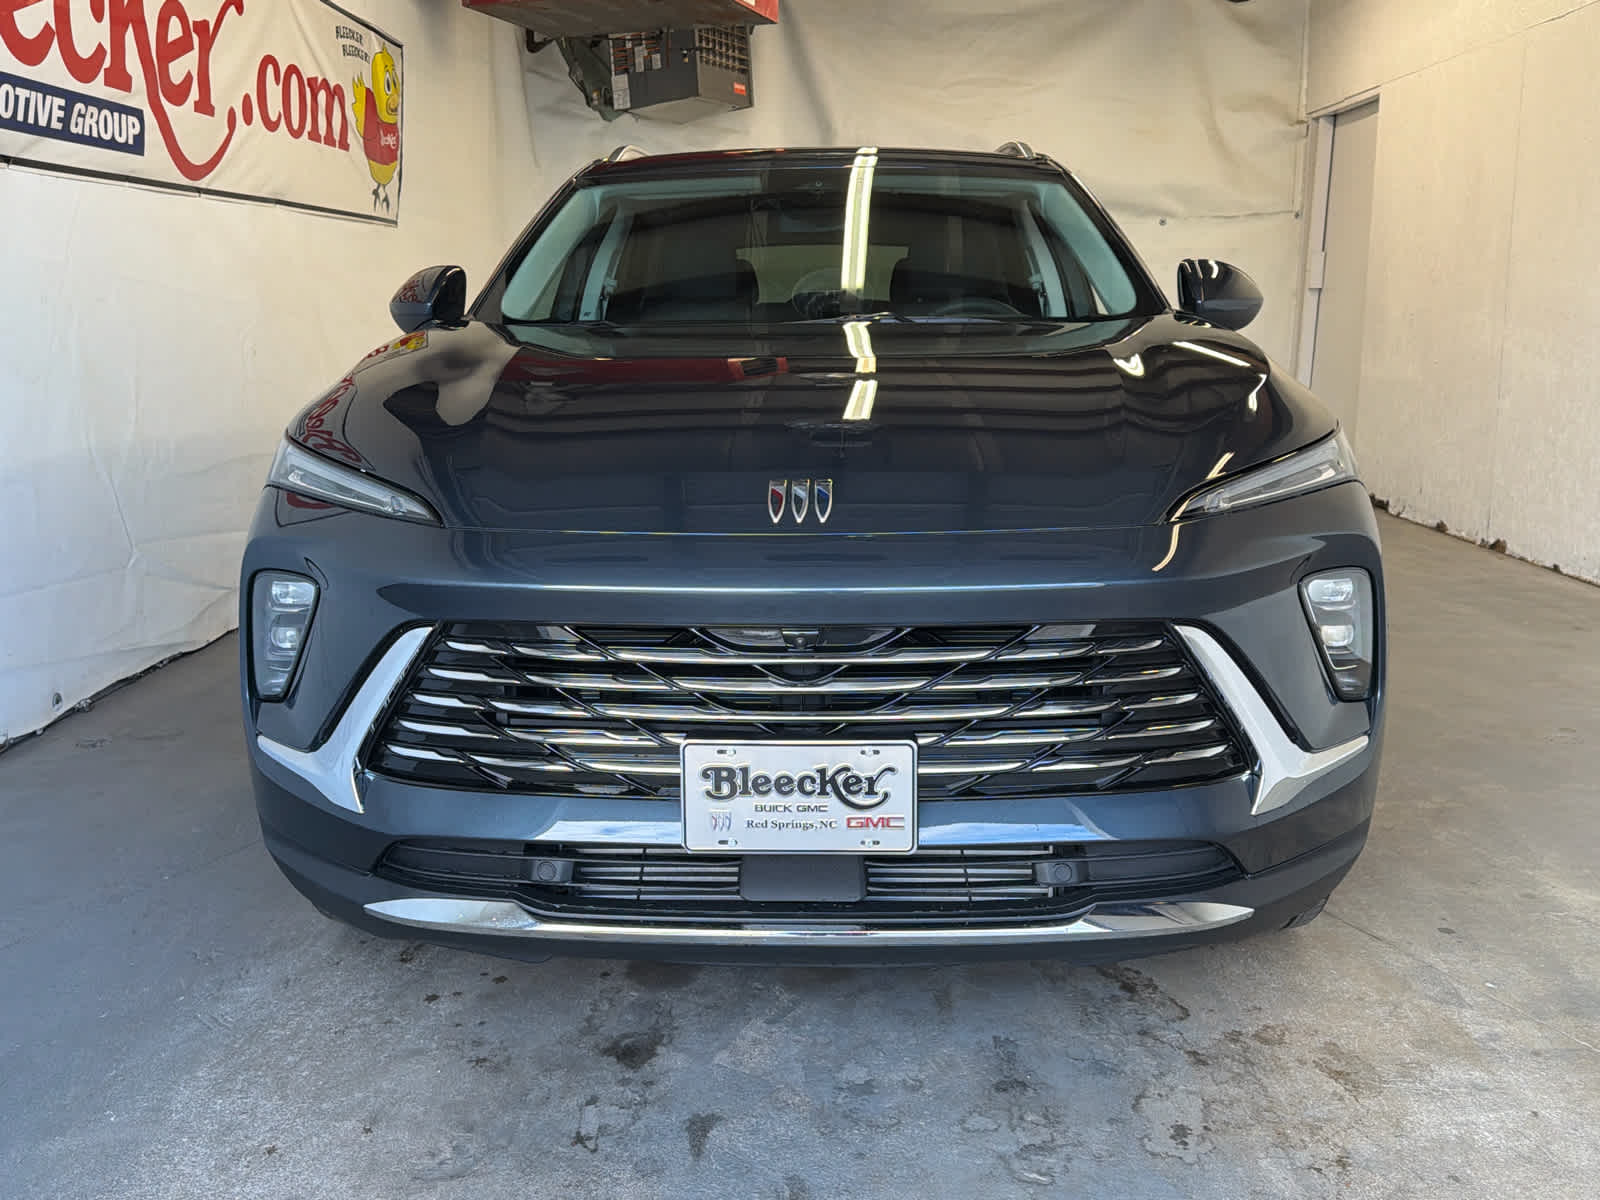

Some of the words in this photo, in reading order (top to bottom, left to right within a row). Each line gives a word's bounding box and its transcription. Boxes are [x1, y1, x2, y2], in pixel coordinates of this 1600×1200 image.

[69, 102, 141, 145] GROUP
[754, 804, 792, 813] BUICK
[796, 804, 828, 813] GMC
[746, 819, 770, 829] Red
[846, 816, 905, 829] GMC
